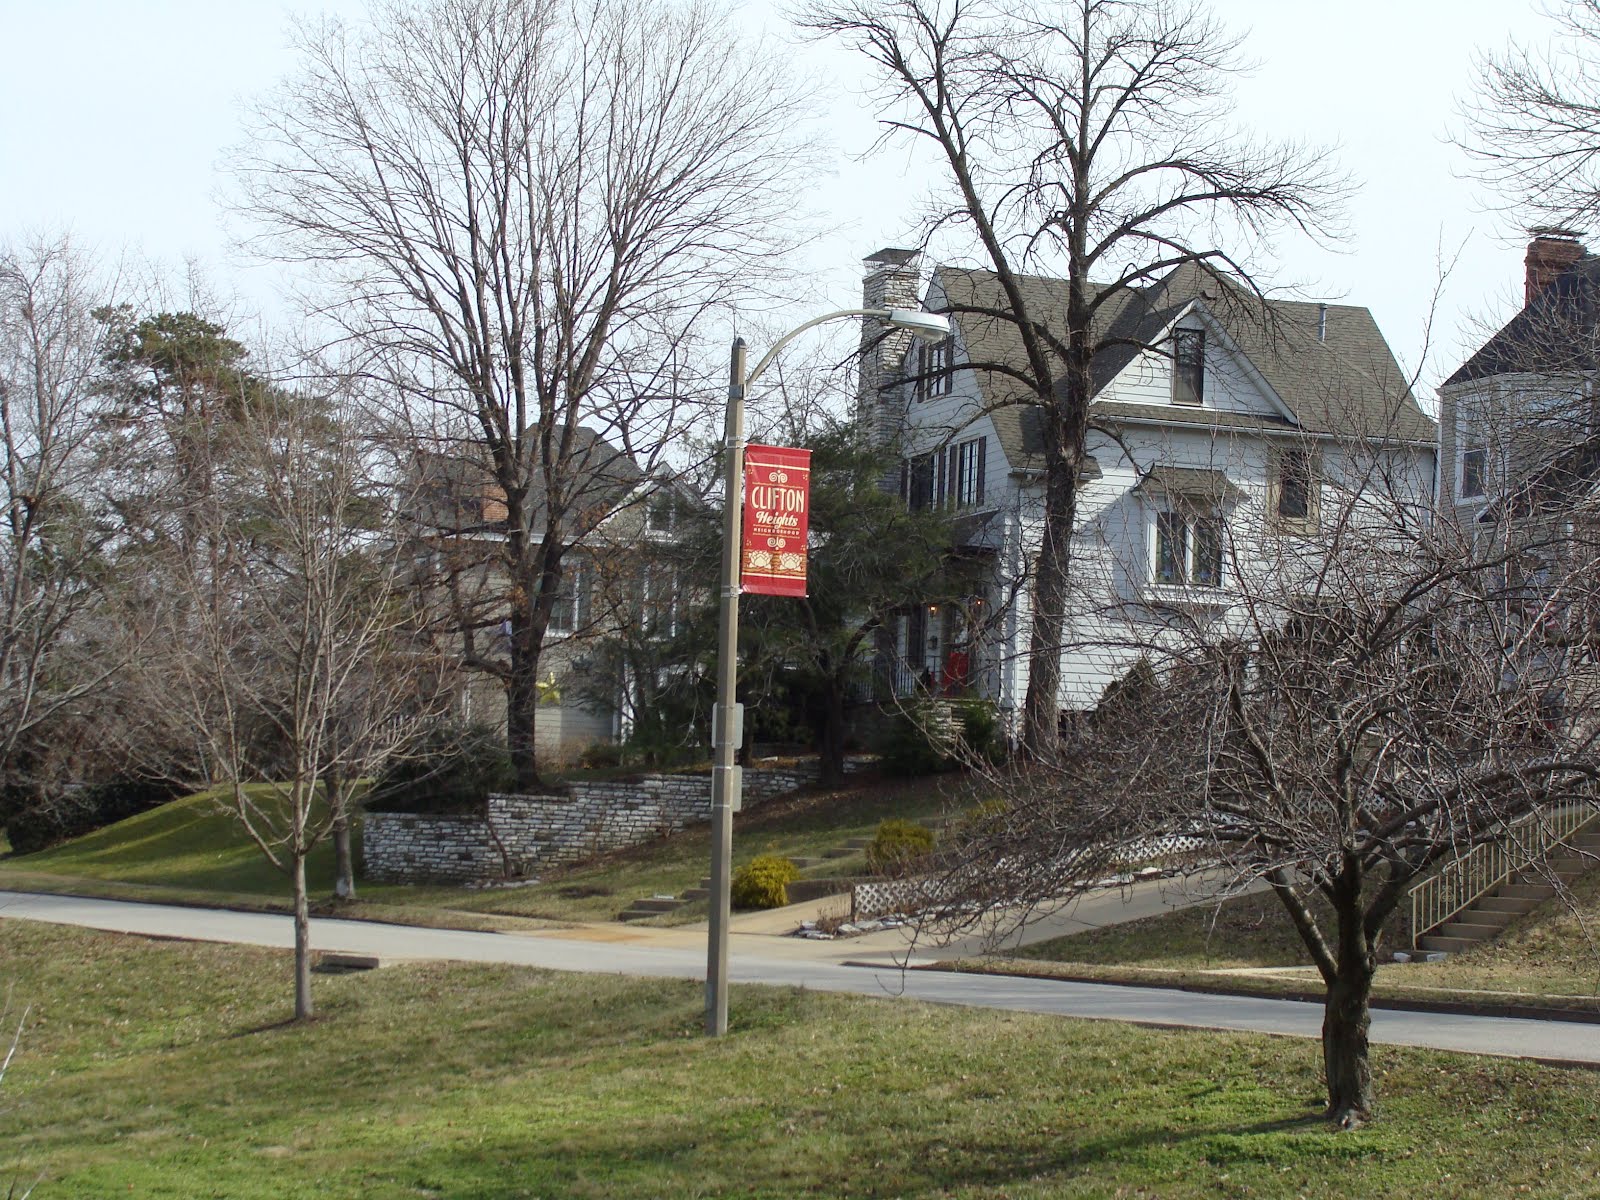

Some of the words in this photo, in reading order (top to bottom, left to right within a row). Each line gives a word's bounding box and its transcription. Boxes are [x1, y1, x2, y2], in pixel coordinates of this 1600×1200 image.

[752, 486, 804, 513] CLIFTON
[756, 511, 798, 529] Heights
[753, 527, 799, 535] NEIGHBORHOOD
